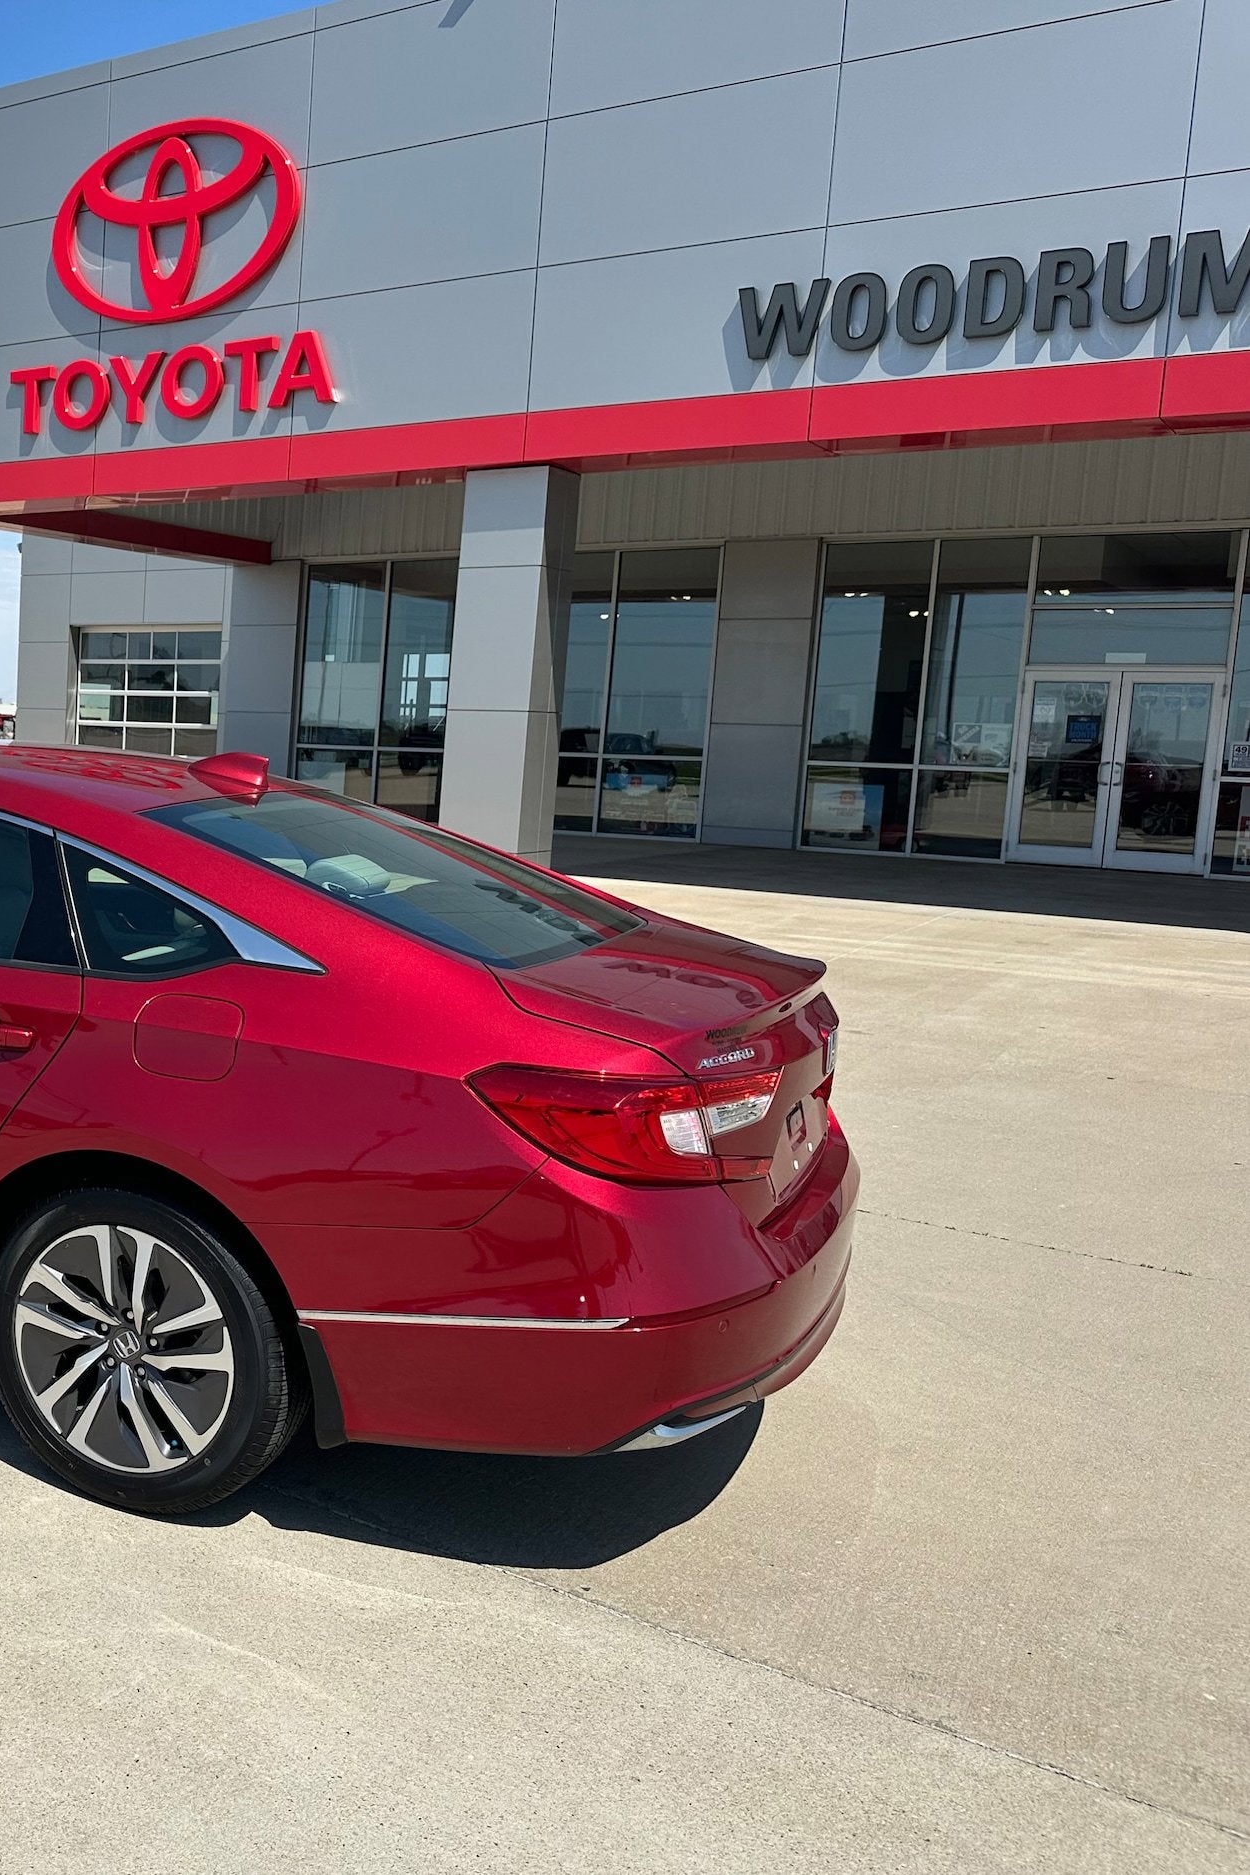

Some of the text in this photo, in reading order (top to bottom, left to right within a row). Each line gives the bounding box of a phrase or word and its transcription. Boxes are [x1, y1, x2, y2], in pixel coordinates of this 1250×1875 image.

[738, 229, 1250, 360] WOODRUM
[10, 330, 339, 435] TOYOTA
[1235, 746, 1248, 754] 49
[697, 1047, 756, 1070] ACCORD
